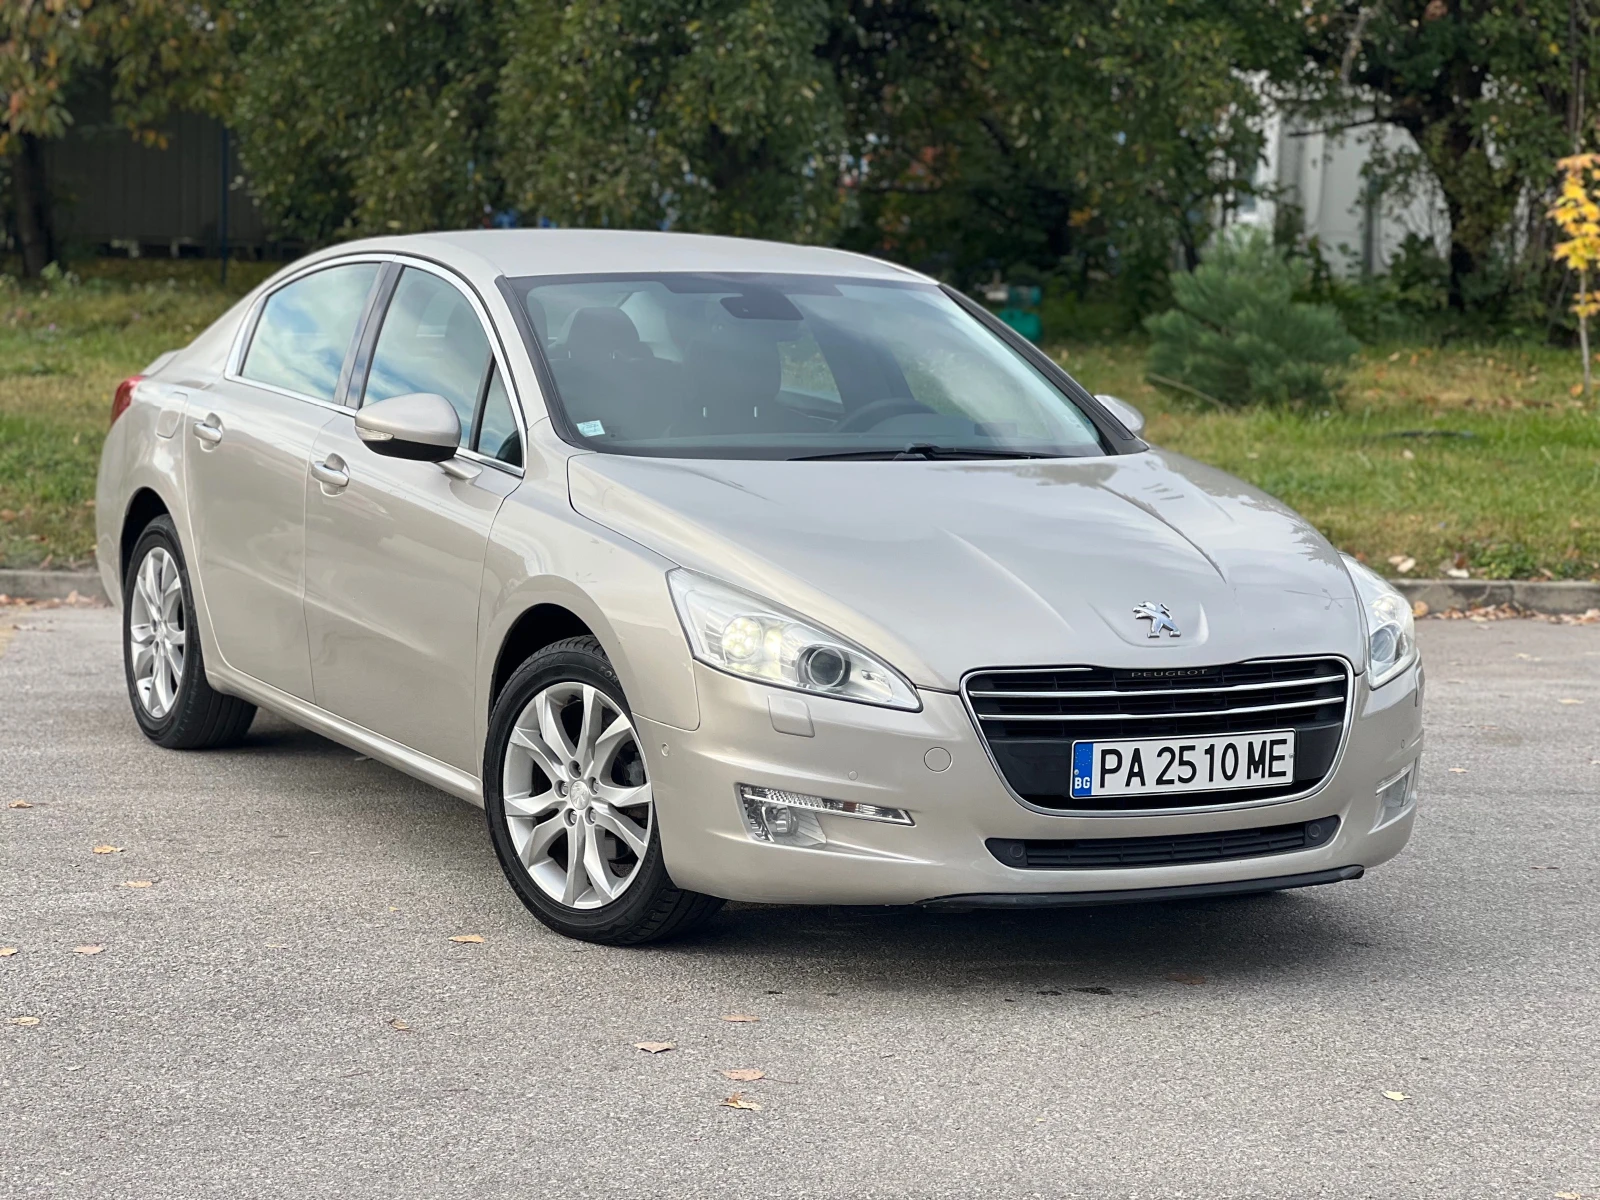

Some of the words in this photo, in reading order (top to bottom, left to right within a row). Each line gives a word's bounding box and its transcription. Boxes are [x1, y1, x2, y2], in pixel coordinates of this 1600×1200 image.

[1131, 668, 1208, 678] PEUGEOT
[1100, 747, 1146, 789] PA
[1155, 742, 1239, 785] 2510
[1246, 738, 1288, 780] ME
[1074, 776, 1091, 790] BG
